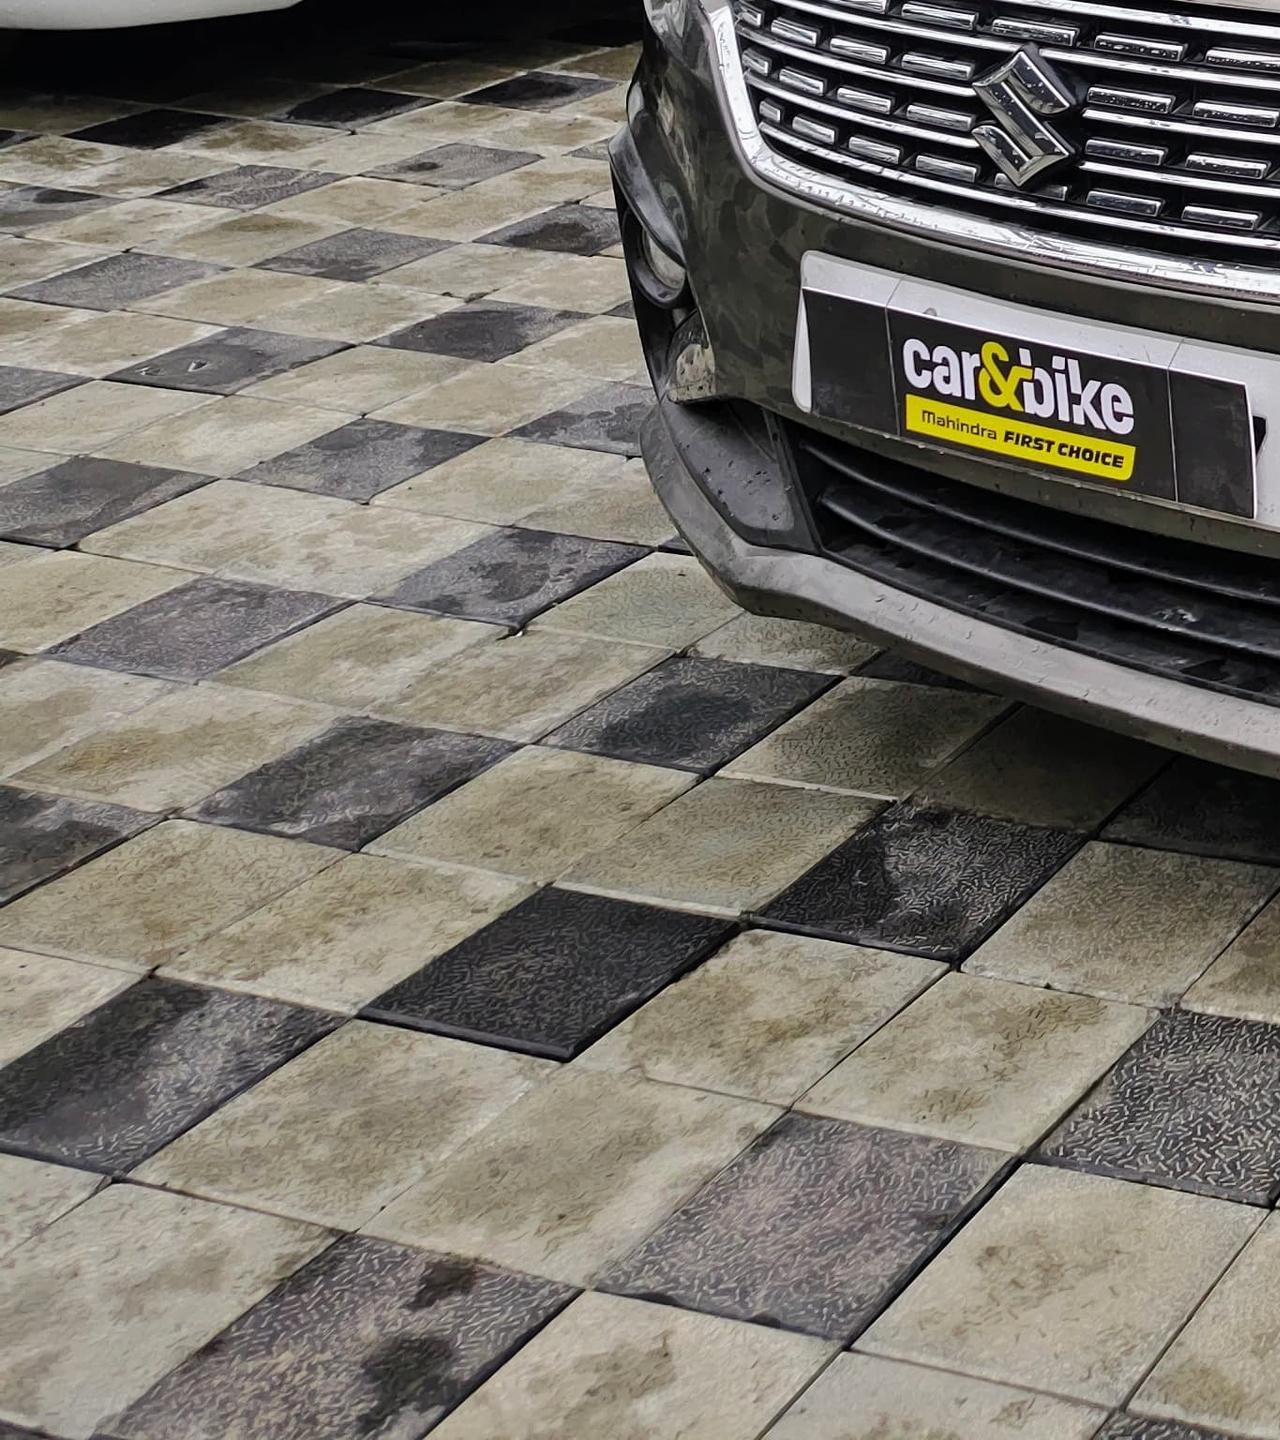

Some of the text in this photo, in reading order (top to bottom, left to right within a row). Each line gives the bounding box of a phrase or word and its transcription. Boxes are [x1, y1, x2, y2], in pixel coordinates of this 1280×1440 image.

[902, 338, 1135, 435] car&bike
[922, 410, 1124, 469] Mahindra FIRST CHOICE
